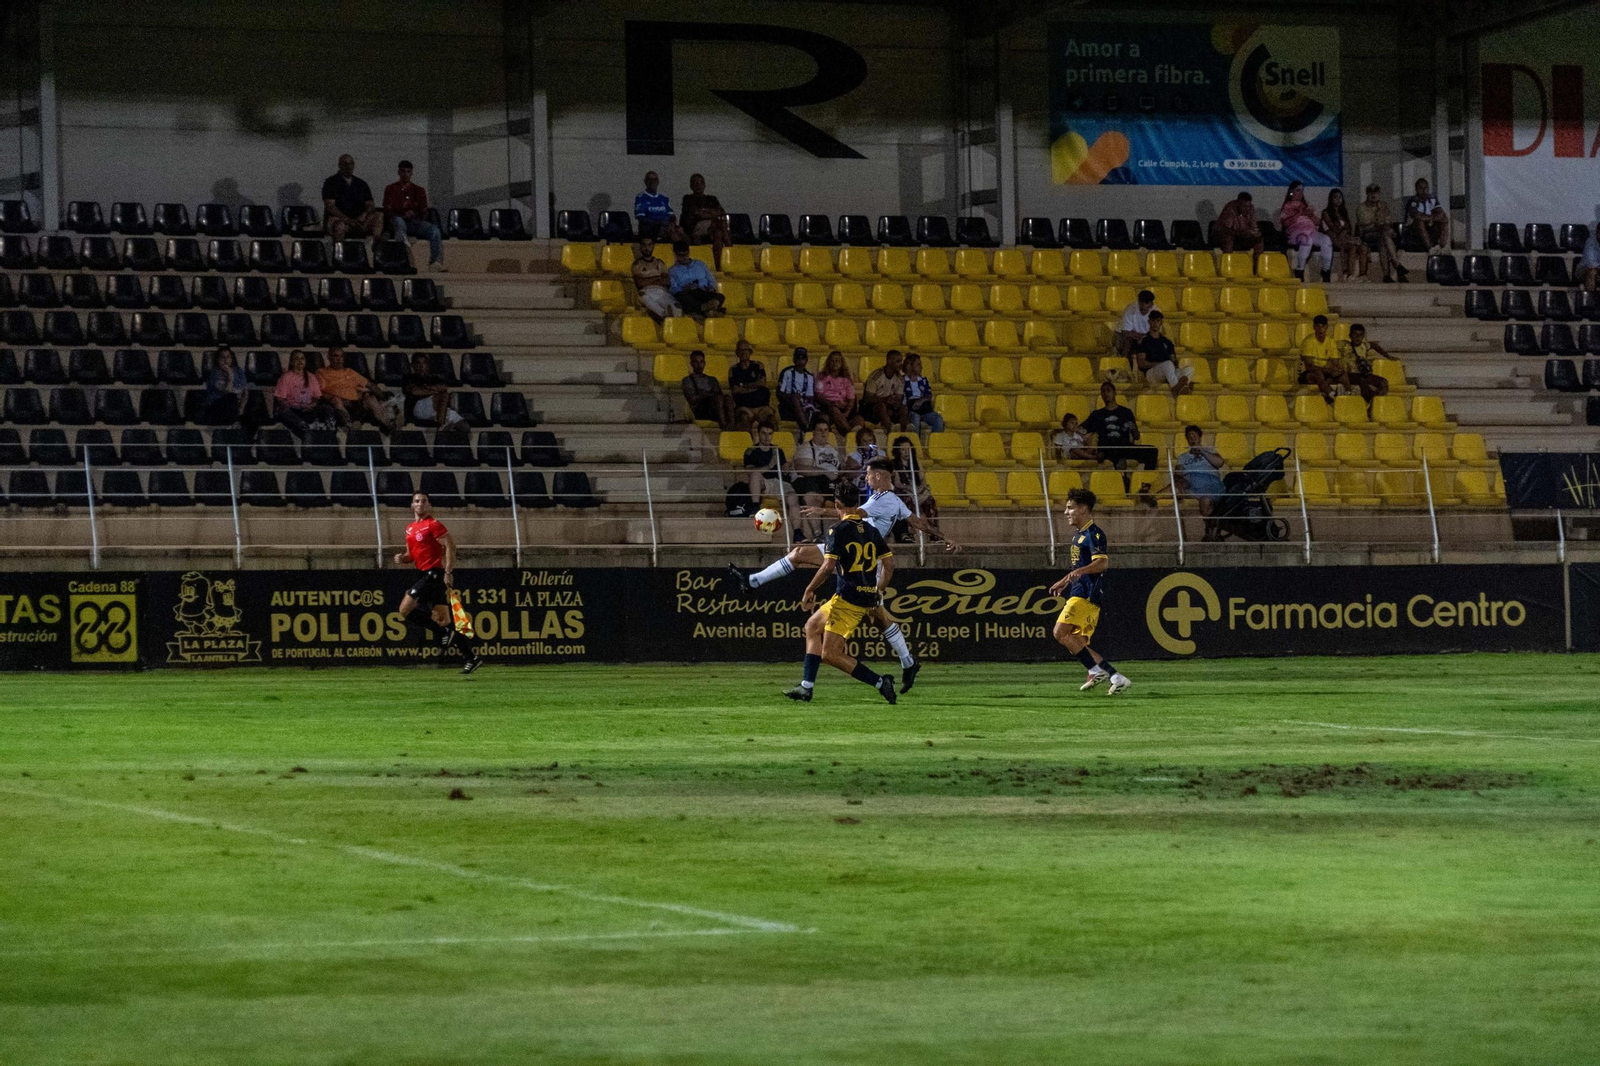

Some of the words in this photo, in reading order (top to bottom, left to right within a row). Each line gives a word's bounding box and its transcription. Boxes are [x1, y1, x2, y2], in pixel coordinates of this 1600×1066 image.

[1065, 38, 1123, 58] Amor
[1129, 42, 1140, 57] a
[1065, 63, 1148, 87] primera
[1154, 64, 1211, 84] fibra.
[1265, 61, 1325, 86] Snell
[624, 20, 868, 160] R
[1481, 62, 1600, 158] DI
[1138, 160, 1158, 168] Calle
[1200, 160, 1220, 169] Lepe
[845, 541, 877, 573] 29
[68, 581, 117, 593] Cadena
[120, 581, 136, 592] 88
[521, 570, 574, 586] Pollería
[675, 570, 722, 591] Bar
[270, 590, 384, 607] AUTENTIC@S
[477, 588, 507, 604] 331
[515, 592, 534, 607] LA
[537, 591, 583, 607] PLAZA
[1228, 594, 1398, 630] Farmacia
[1407, 592, 1527, 627] Centro
[270, 612, 407, 642] POLLOS
[693, 622, 767, 638] Avenida
[926, 622, 970, 642] Lepe
[985, 622, 1046, 639] Huelva
[183, 640, 200, 649] LA
[203, 640, 244, 649] PLAZA
[272, 649, 283, 658] DE
[285, 648, 331, 658] PORTUGAL
[333, 648, 343, 657] AL
[346, 645, 382, 657] CARBÓN
[864, 641, 887, 657] 56
[918, 641, 940, 657] 28
